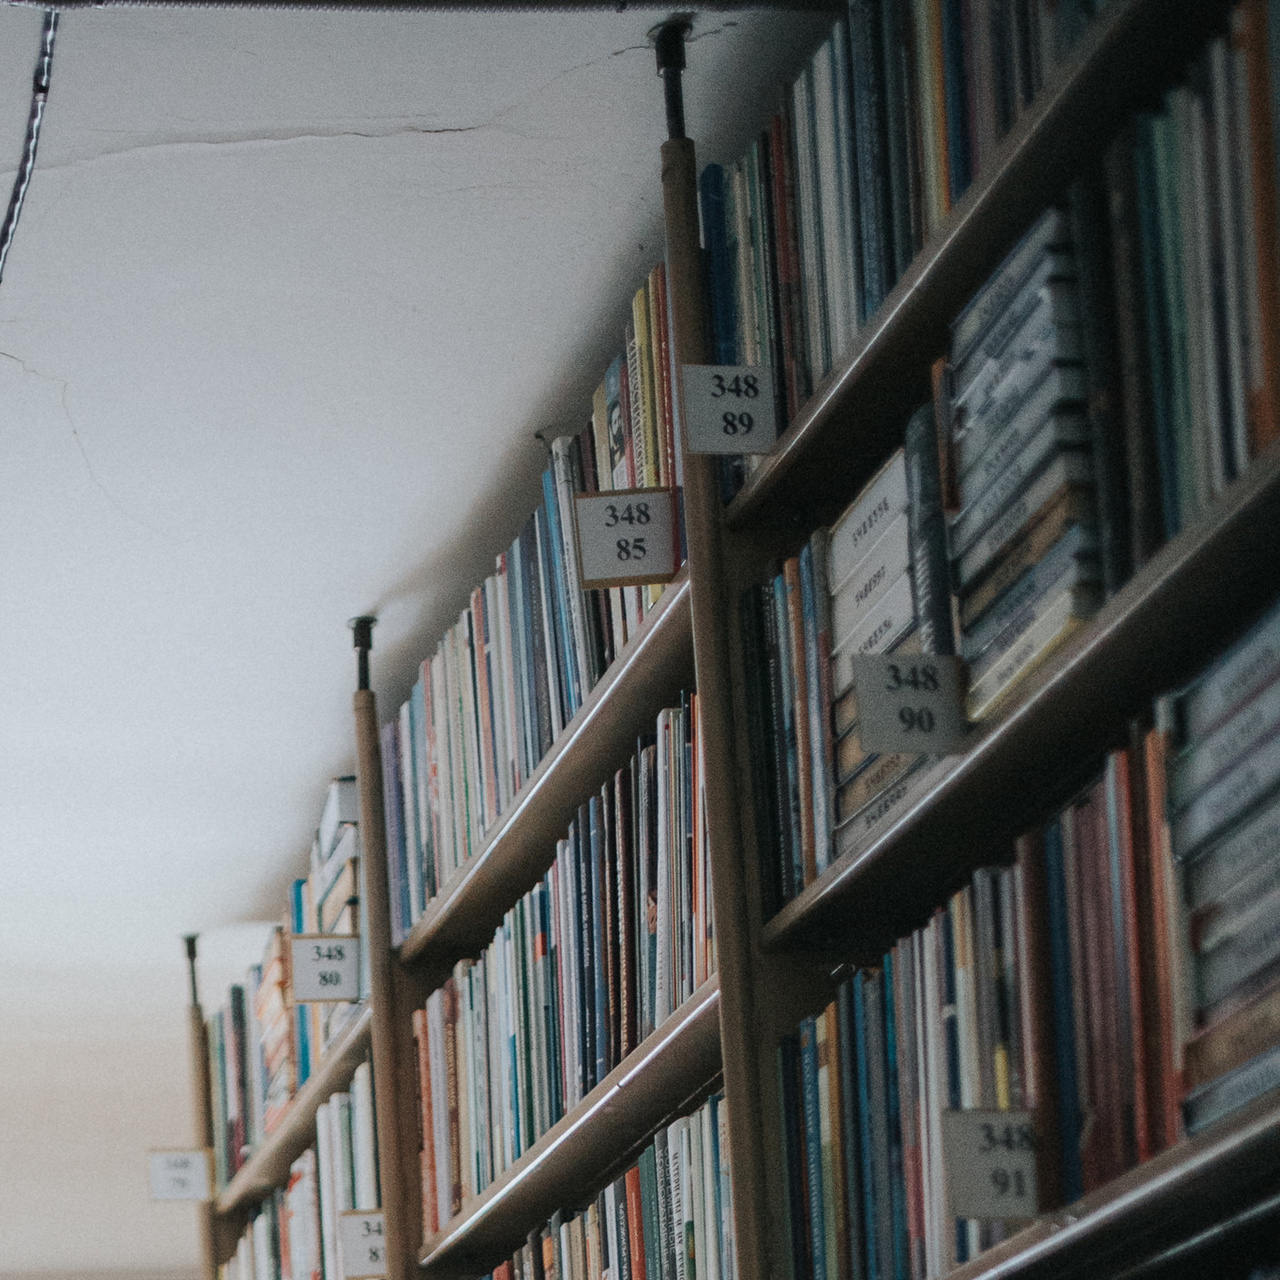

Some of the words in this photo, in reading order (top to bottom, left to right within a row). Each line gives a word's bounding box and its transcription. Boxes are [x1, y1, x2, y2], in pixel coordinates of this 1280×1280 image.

[711, 374, 759, 400] 348
[722, 411, 754, 437] 89
[604, 502, 651, 528] 348
[616, 538, 647, 562] 85
[886, 665, 939, 692] 348
[898, 707, 935, 734] 90
[311, 945, 345, 964] 348
[319, 970, 342, 988] 80
[991, 1168, 1025, 1197] 91
